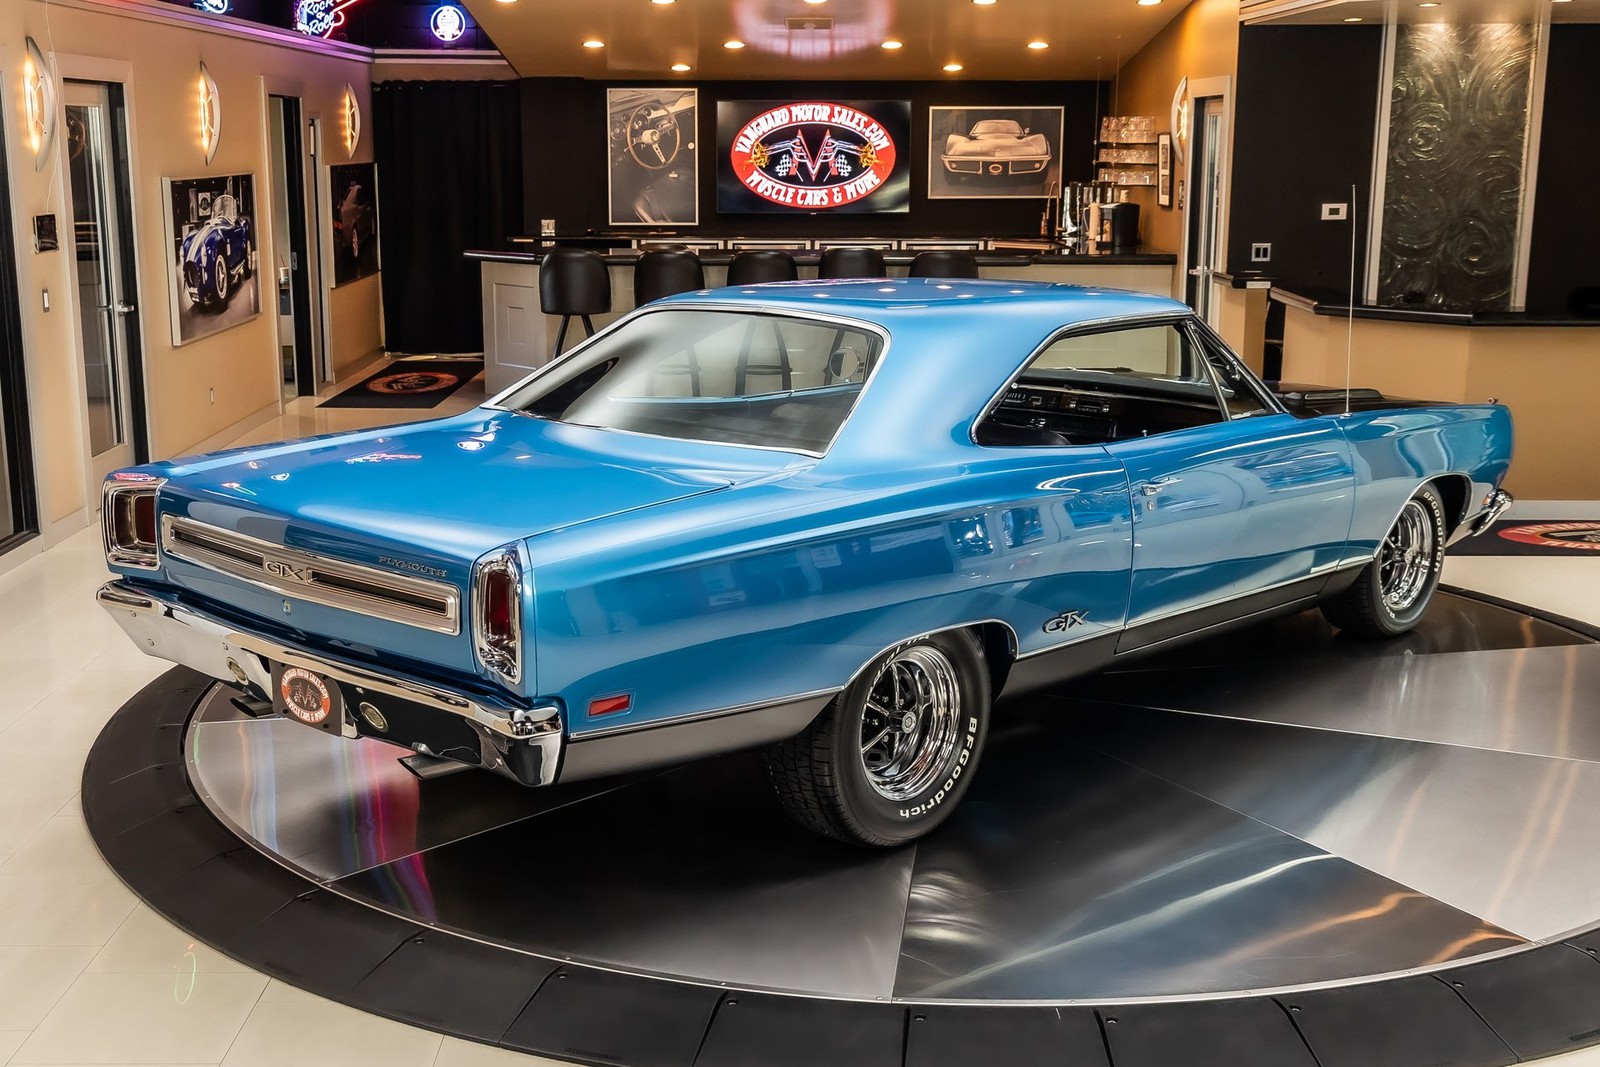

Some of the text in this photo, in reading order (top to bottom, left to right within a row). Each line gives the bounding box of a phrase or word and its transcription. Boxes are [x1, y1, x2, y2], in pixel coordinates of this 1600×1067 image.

[735, 104, 890, 154] VANGUARD MOTOR SALES.COM
[745, 170, 881, 206] MUSCLE CARS & MORE
[265, 561, 304, 581] GTX
[378, 555, 448, 578] PLYMOUTH
[1042, 609, 1090, 634] GTX
[899, 717, 978, 818] BFGoodrich
